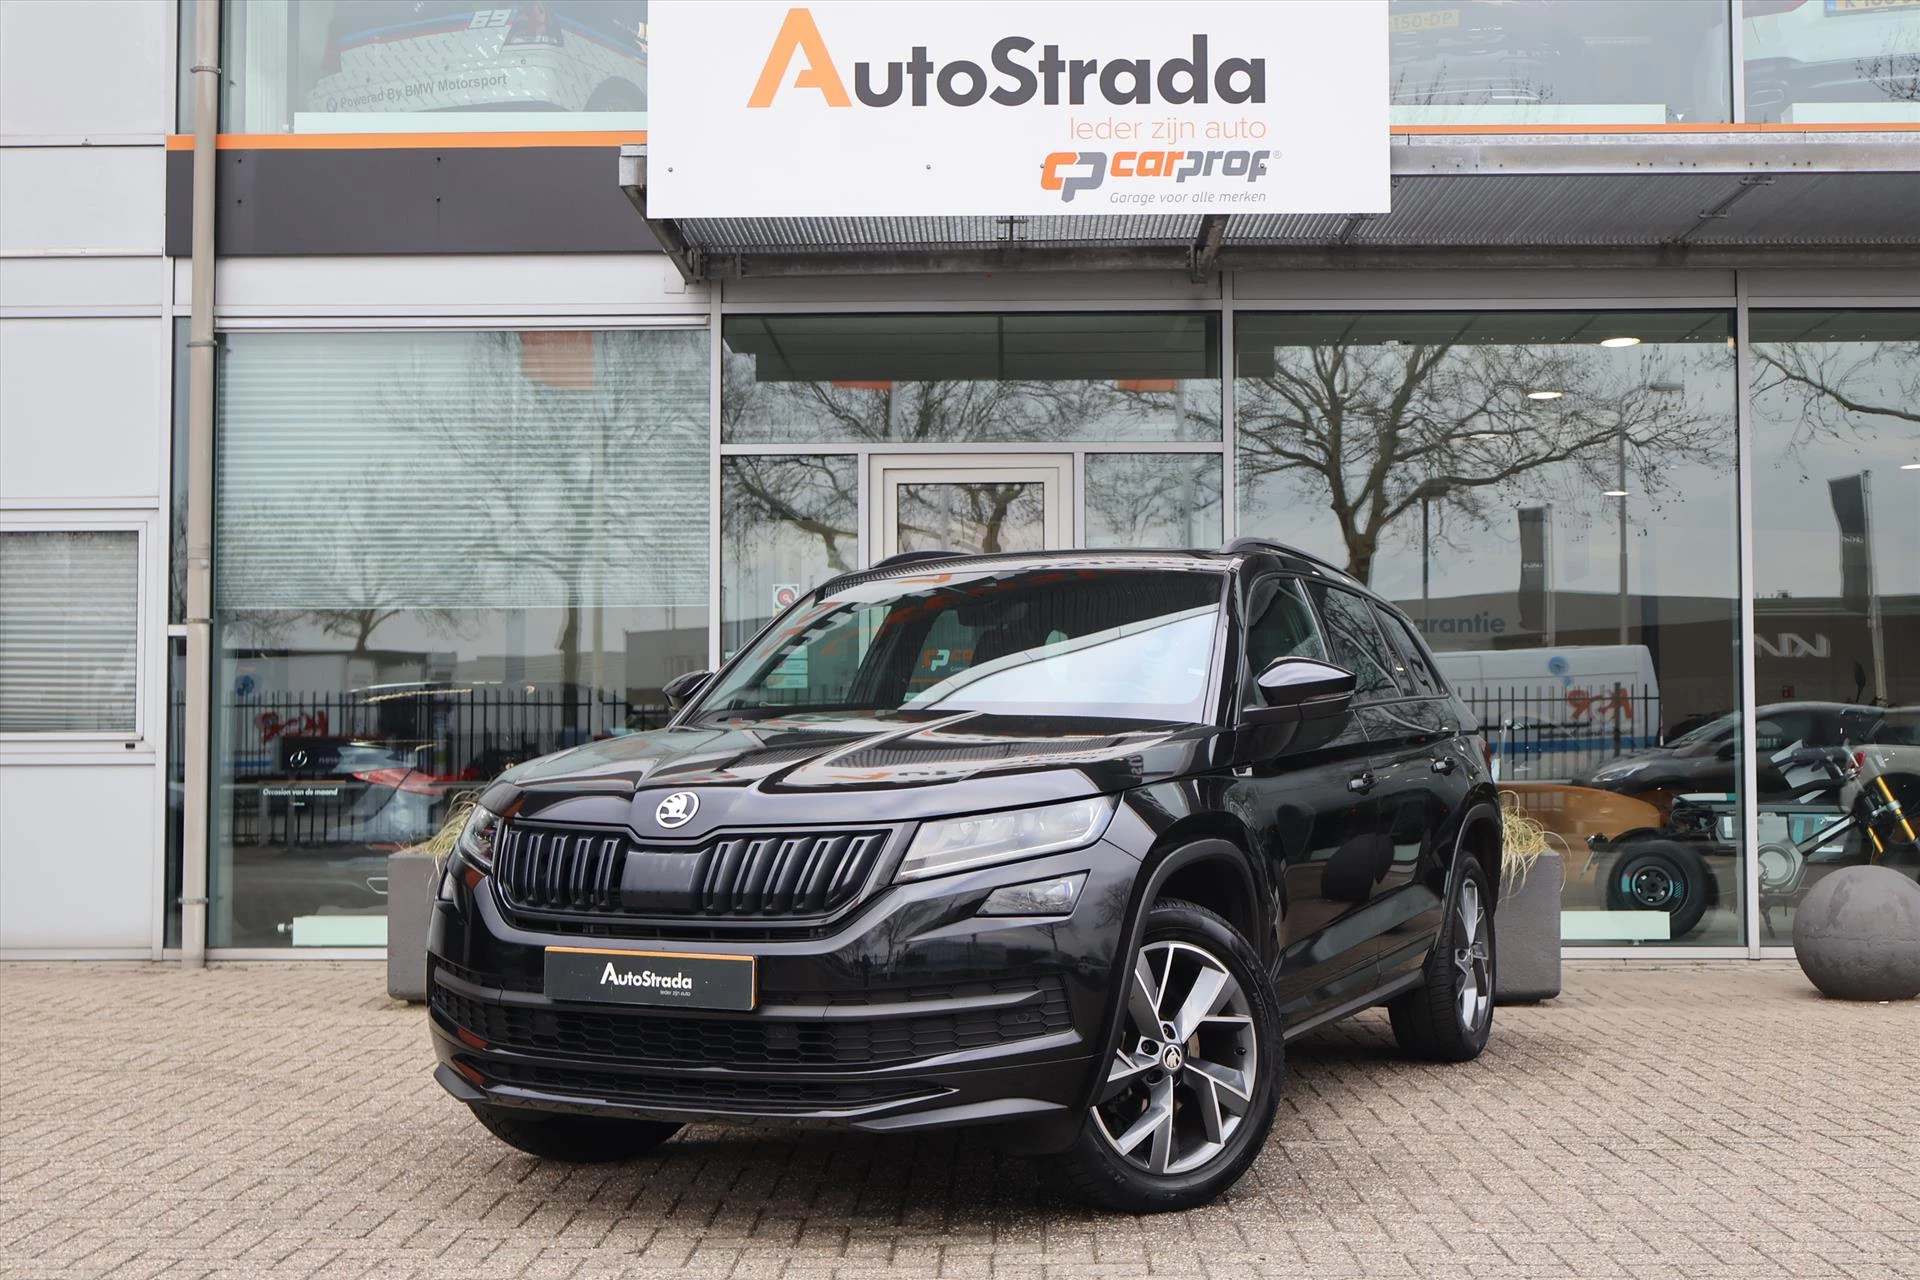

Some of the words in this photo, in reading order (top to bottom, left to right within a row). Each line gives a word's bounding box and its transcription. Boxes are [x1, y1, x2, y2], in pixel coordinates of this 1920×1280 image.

[469, 9, 512, 29] 69
[746, 8, 1266, 107] AutoStrada
[340, 91, 384, 107] Powered
[387, 87, 401, 103] By
[405, 82, 434, 97] BMW
[438, 74, 508, 93] Motorsport
[1069, 116, 1143, 140] Ieder
[1151, 117, 1195, 145] zijn
[1204, 118, 1267, 140] auto
[1110, 150, 1271, 183] carprof
[1110, 191, 1155, 206] Garage
[1160, 192, 1189, 203] voor
[1193, 190, 1215, 203] alle
[1219, 190, 1267, 203] merken
[600, 962, 692, 989] AutoStrada
